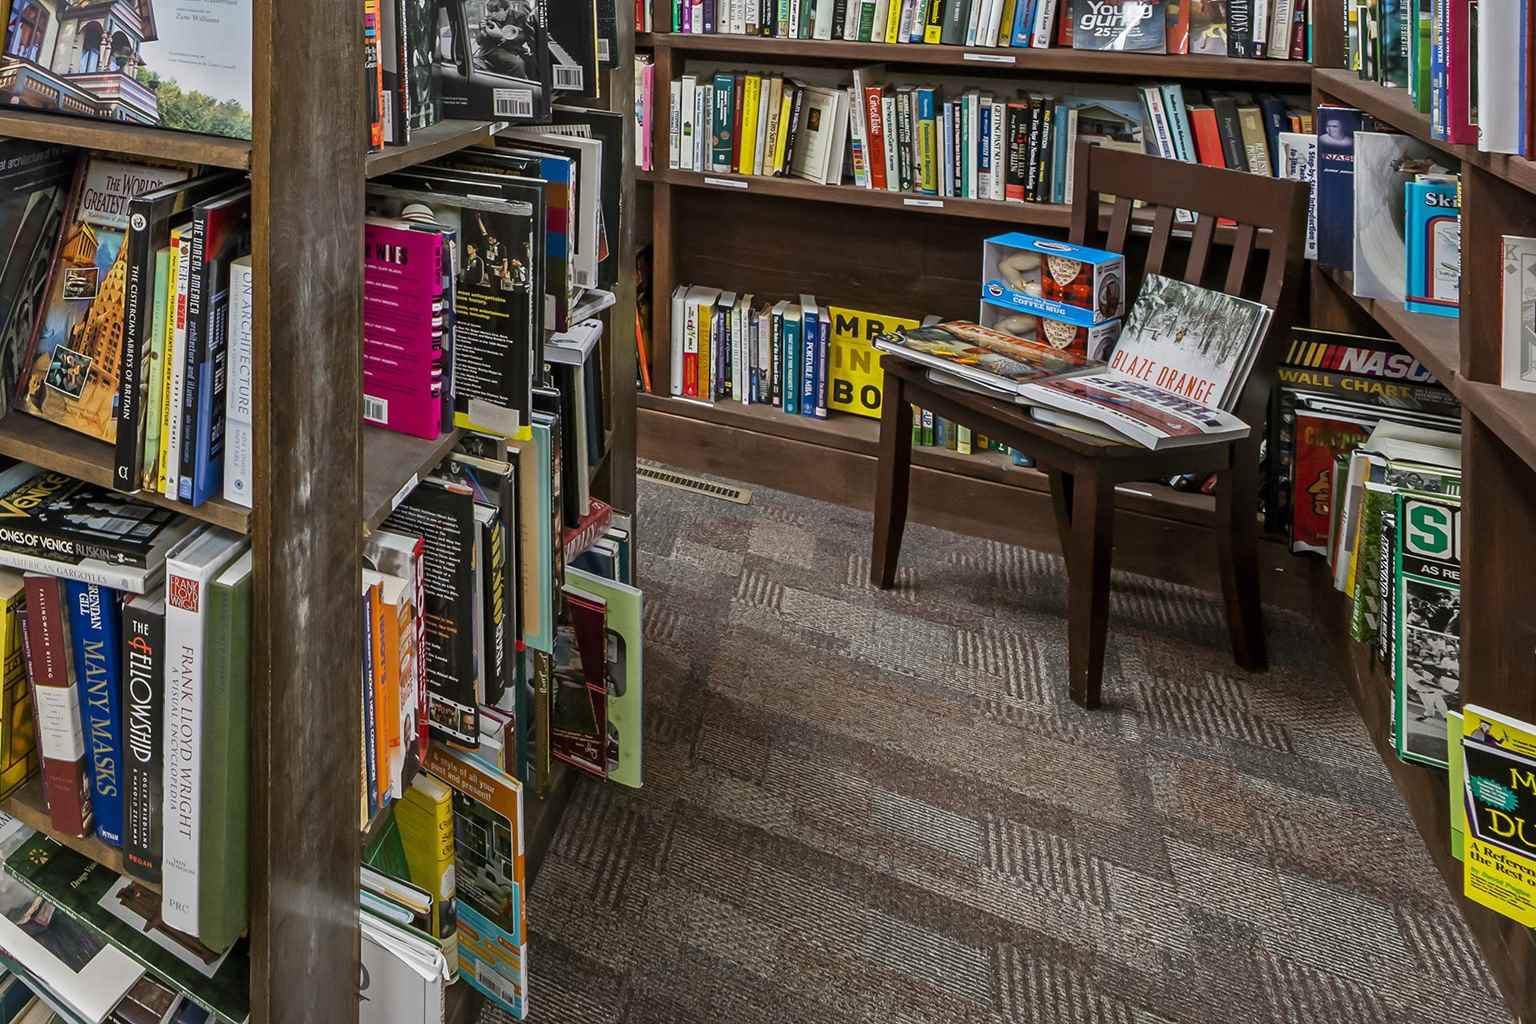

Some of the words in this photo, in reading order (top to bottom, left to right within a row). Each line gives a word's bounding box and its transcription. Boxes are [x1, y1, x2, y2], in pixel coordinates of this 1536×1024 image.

[1093, 26, 1112, 37] 25
[105, 175, 123, 192] THE
[83, 188, 125, 213] GREATEST
[195, 218, 204, 233] THE
[192, 232, 204, 271] UNREAL
[132, 264, 140, 280] THE
[241, 272, 253, 295] ON
[129, 279, 139, 336] CISTERCIAN
[189, 271, 202, 316] AMERICA
[1012, 296, 1046, 309] COFFEE
[1045, 305, 1066, 316] MUG
[127, 335, 136, 368] ABBEYS
[237, 297, 253, 417] ARCHITECTURE
[835, 345, 871, 374] IN
[1338, 346, 1442, 384] NASC
[1110, 349, 1157, 383] BLAZE
[1155, 366, 1217, 405] ORANGE
[1278, 369, 1336, 388] WALL
[1338, 377, 1412, 400] CHART
[123, 383, 133, 420] BRITAIN
[24, 533, 40, 548] OF
[39, 536, 74, 555] VENICE
[74, 543, 110, 559] RUSKIN
[1420, 563, 1440, 577] AS
[132, 620, 149, 636] THE
[82, 639, 109, 712] MANY
[181, 644, 195, 703] FRANK
[127, 636, 153, 764] FELLOWSHIP
[179, 705, 193, 763] LLOYD
[89, 715, 118, 798] MASKS
[177, 765, 192, 841] WRIGHT
[1470, 850, 1493, 869] the
[1495, 859, 1524, 883] Rest
